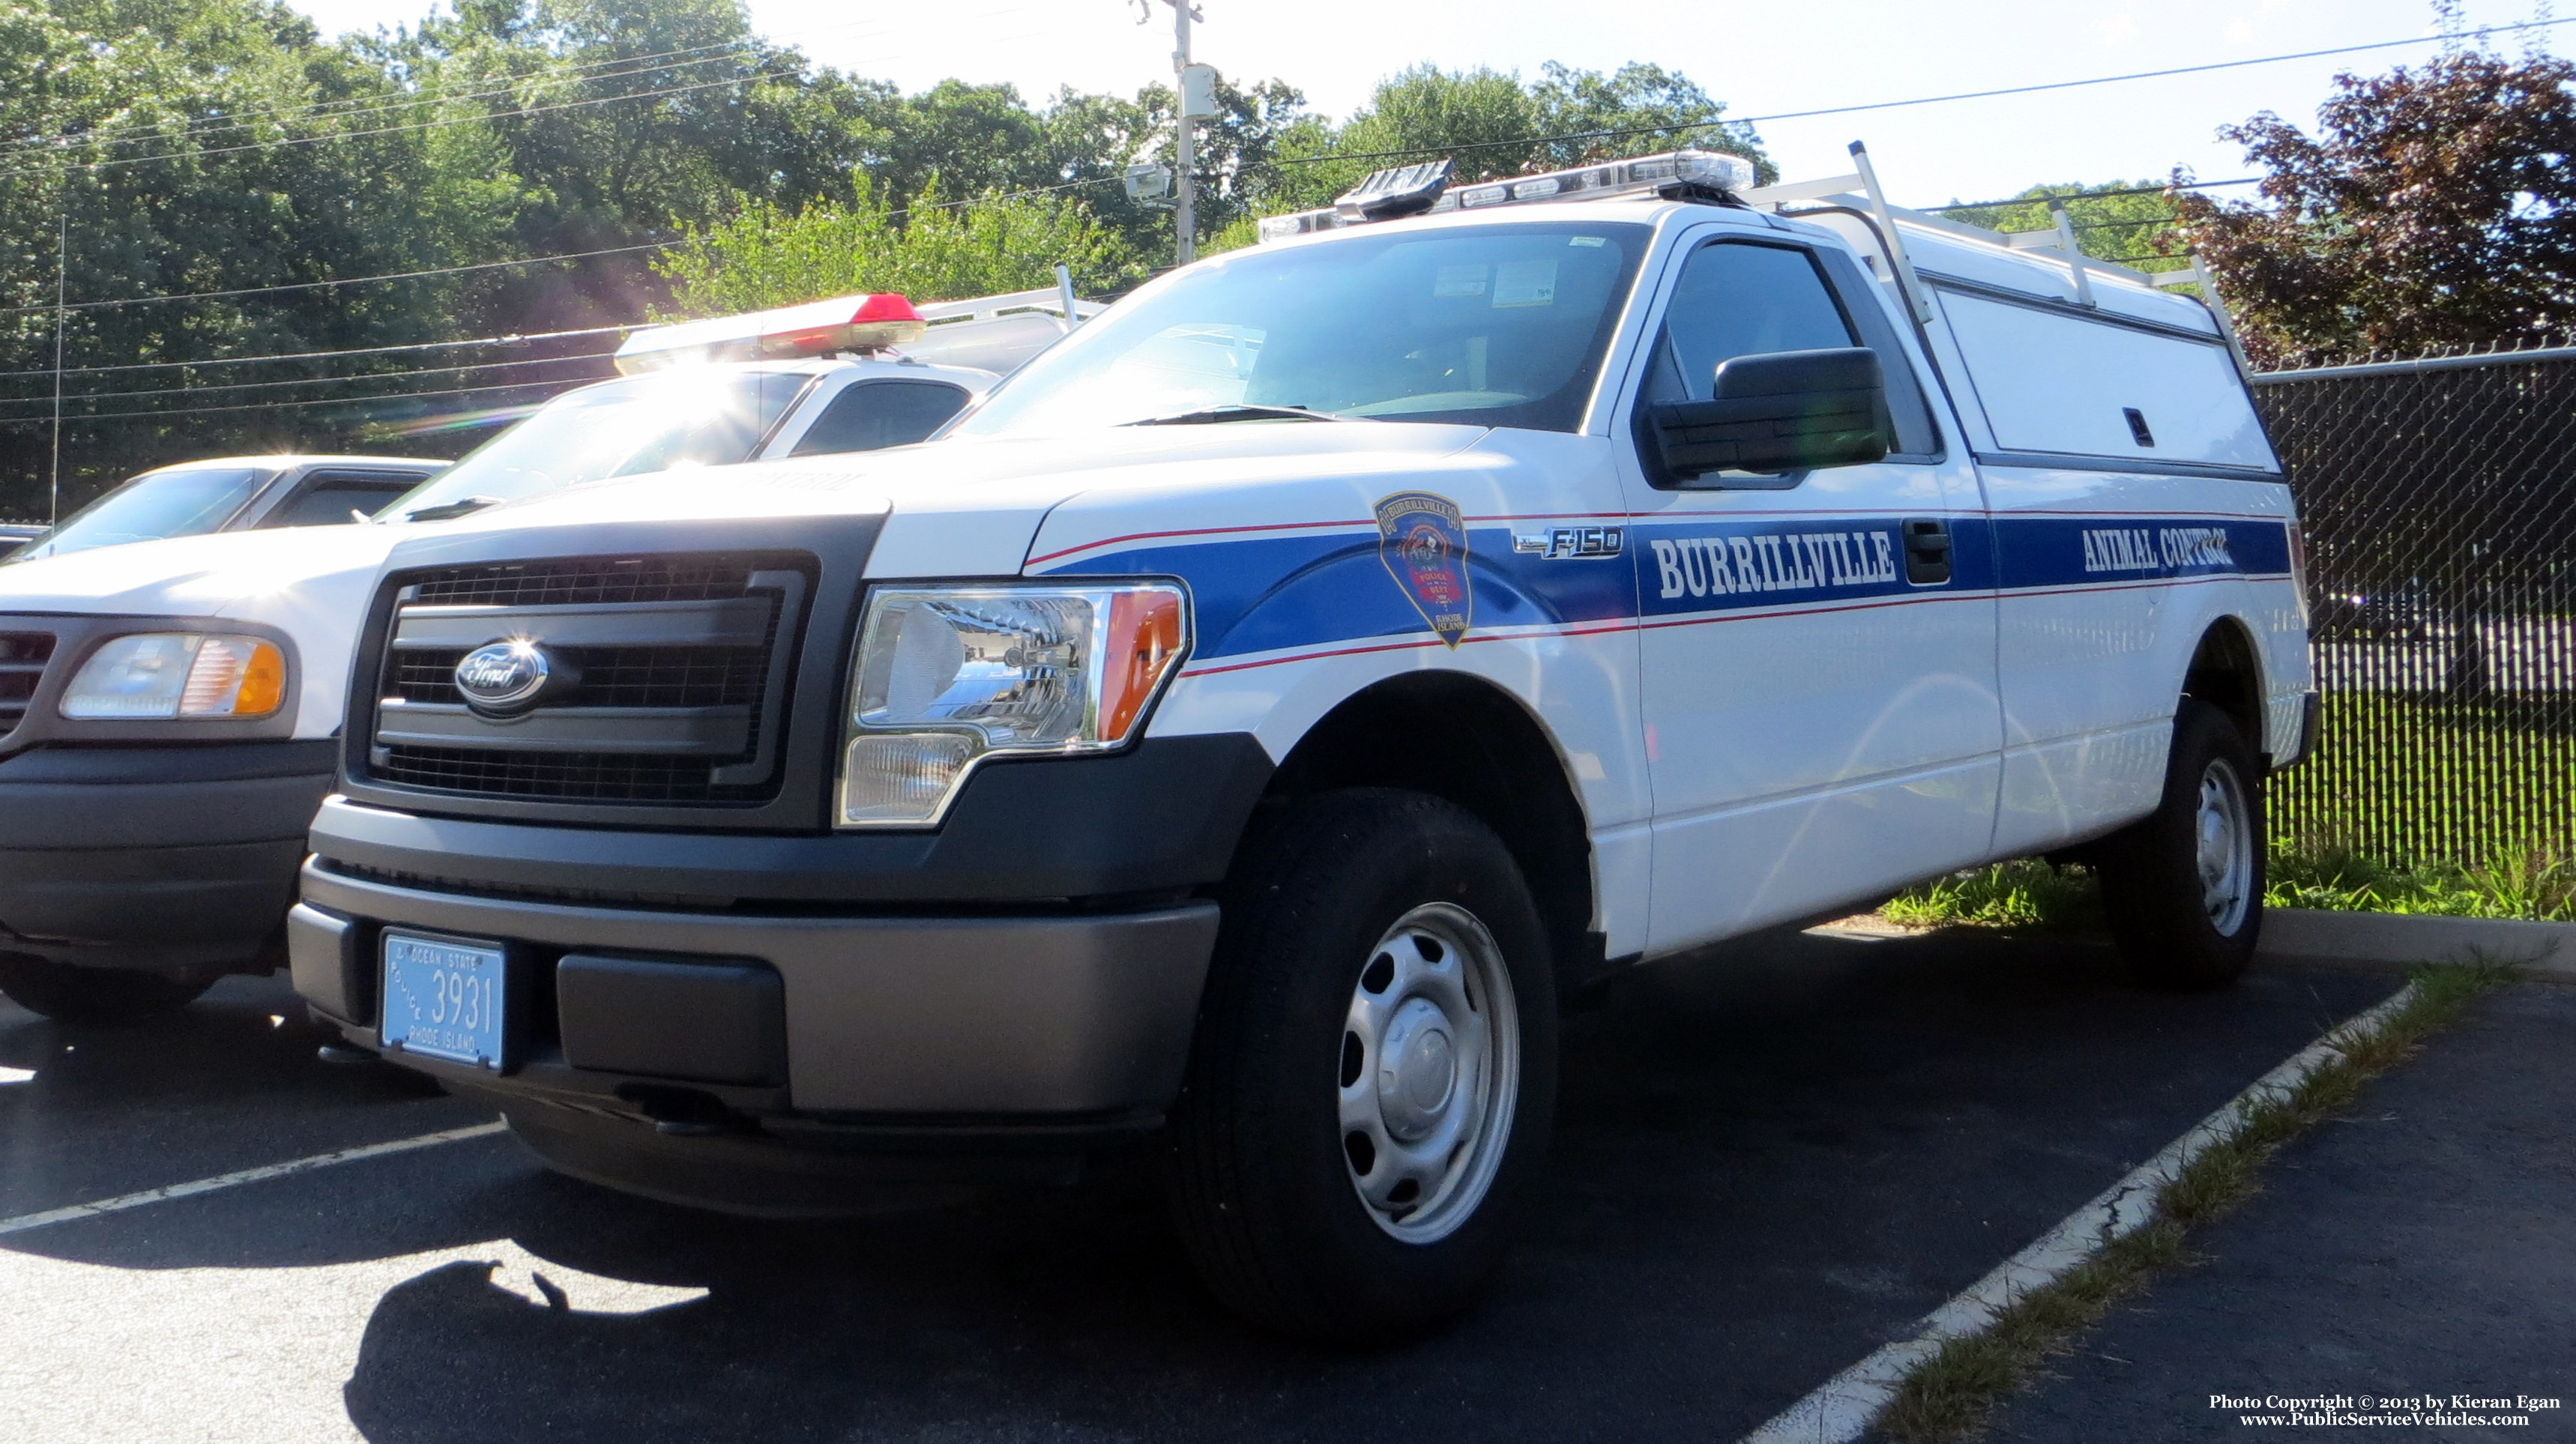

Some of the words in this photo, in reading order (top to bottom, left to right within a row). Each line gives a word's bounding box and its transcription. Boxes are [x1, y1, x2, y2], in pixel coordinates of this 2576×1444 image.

[1388, 499, 1447, 516] BURRILLVILLE
[1548, 527, 1623, 556] F-150
[2082, 529, 2159, 572] ANIMAL
[2159, 528, 2233, 568] CONTROL
[1651, 531, 1897, 598] BURRILLVILLE
[1435, 613, 1463, 623] RHODE
[1438, 621, 1465, 632] ISLAND
[468, 653, 519, 688] Ford
[411, 947, 442, 965] OCEAN
[448, 952, 477, 971] STATE
[390, 961, 422, 1021] POLICE
[431, 969, 492, 1034] 3931
[408, 1024, 439, 1047] RHODE
[443, 1030, 475, 1054] ISLAND
